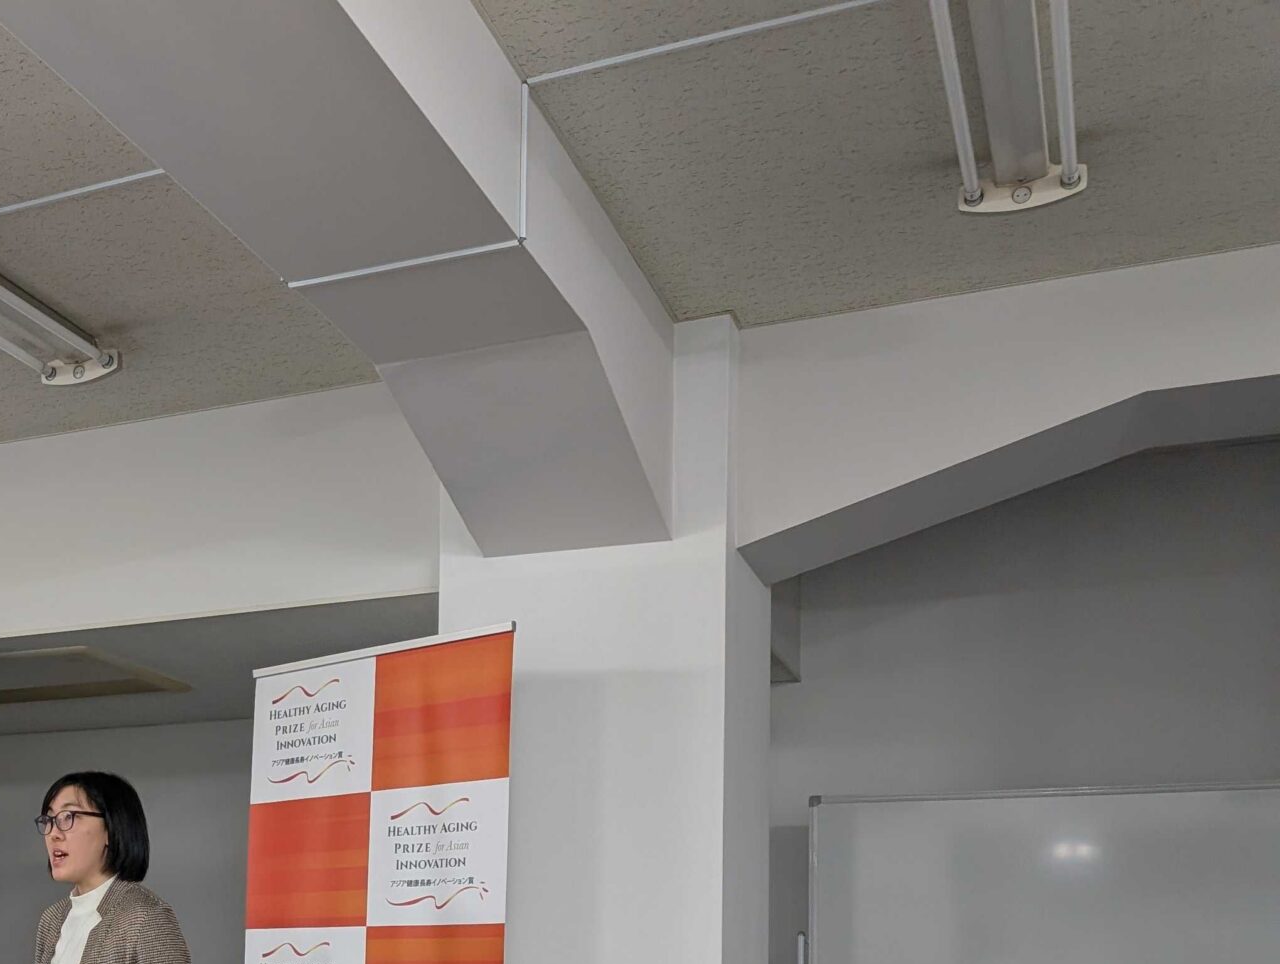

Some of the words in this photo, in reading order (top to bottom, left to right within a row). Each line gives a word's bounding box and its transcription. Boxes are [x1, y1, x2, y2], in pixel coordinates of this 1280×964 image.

[269, 705, 312, 720] HEALTHY
[313, 700, 347, 713] AGING
[275, 723, 305, 736] PRIZE
[306, 720, 317, 734] for
[318, 718, 340, 729] Asian
[276, 733, 337, 751] INNOVATION
[387, 823, 439, 837] HEALTHY
[439, 821, 478, 834] AGING
[394, 843, 431, 854] PRIZE
[433, 842, 447, 855] for
[446, 840, 470, 851] Asian
[395, 857, 467, 871] INNOVATION
